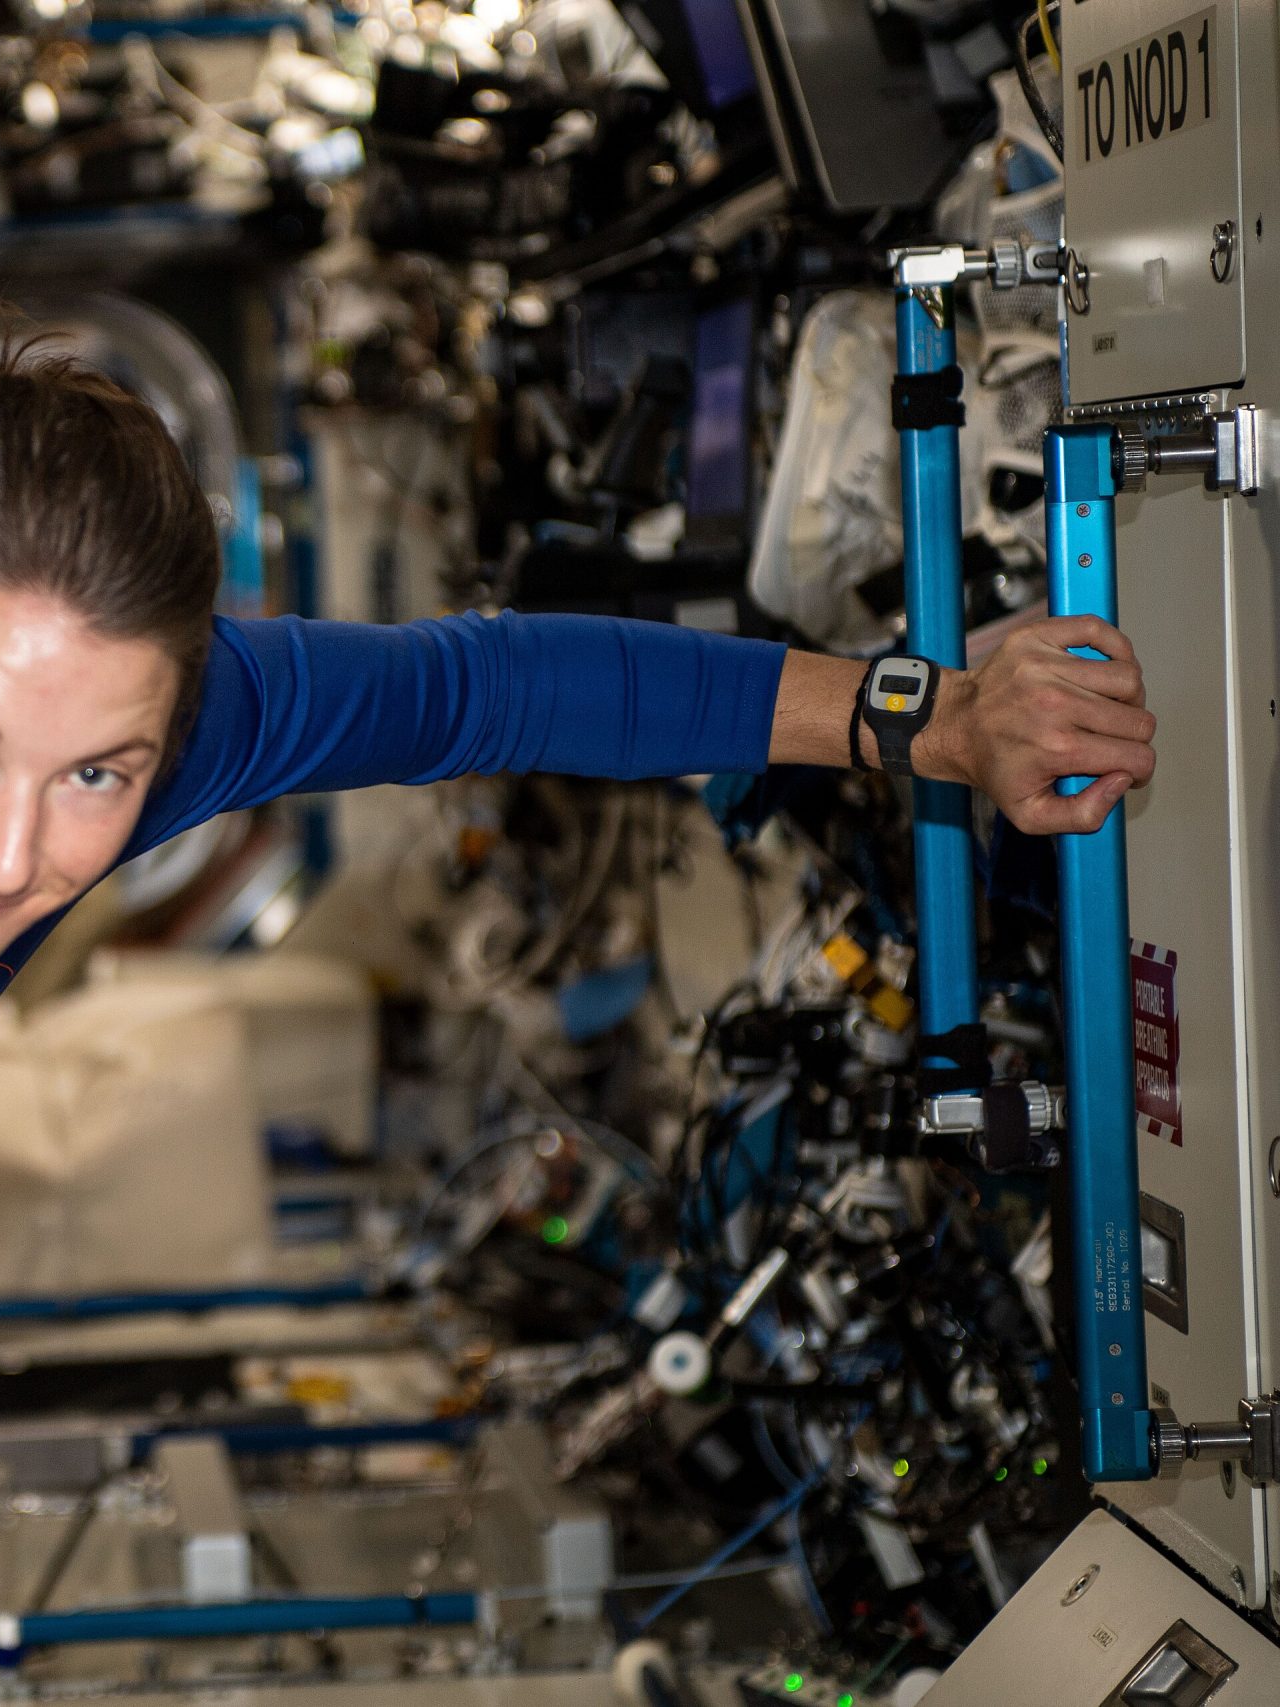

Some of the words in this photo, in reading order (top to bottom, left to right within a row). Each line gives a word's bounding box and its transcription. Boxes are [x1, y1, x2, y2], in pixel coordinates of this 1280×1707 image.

[1078, 61, 1115, 162] TO
[1124, 30, 1188, 147] NOD
[1198, 18, 1210, 118] 1
[1135, 978, 1166, 1018] PORTABLE
[1135, 1018, 1168, 1060] BREATHING
[1135, 1059, 1170, 1102] APPARATUS
[1095, 1240, 1103, 1283] Handrail
[1122, 1279, 1131, 1311] Serial
